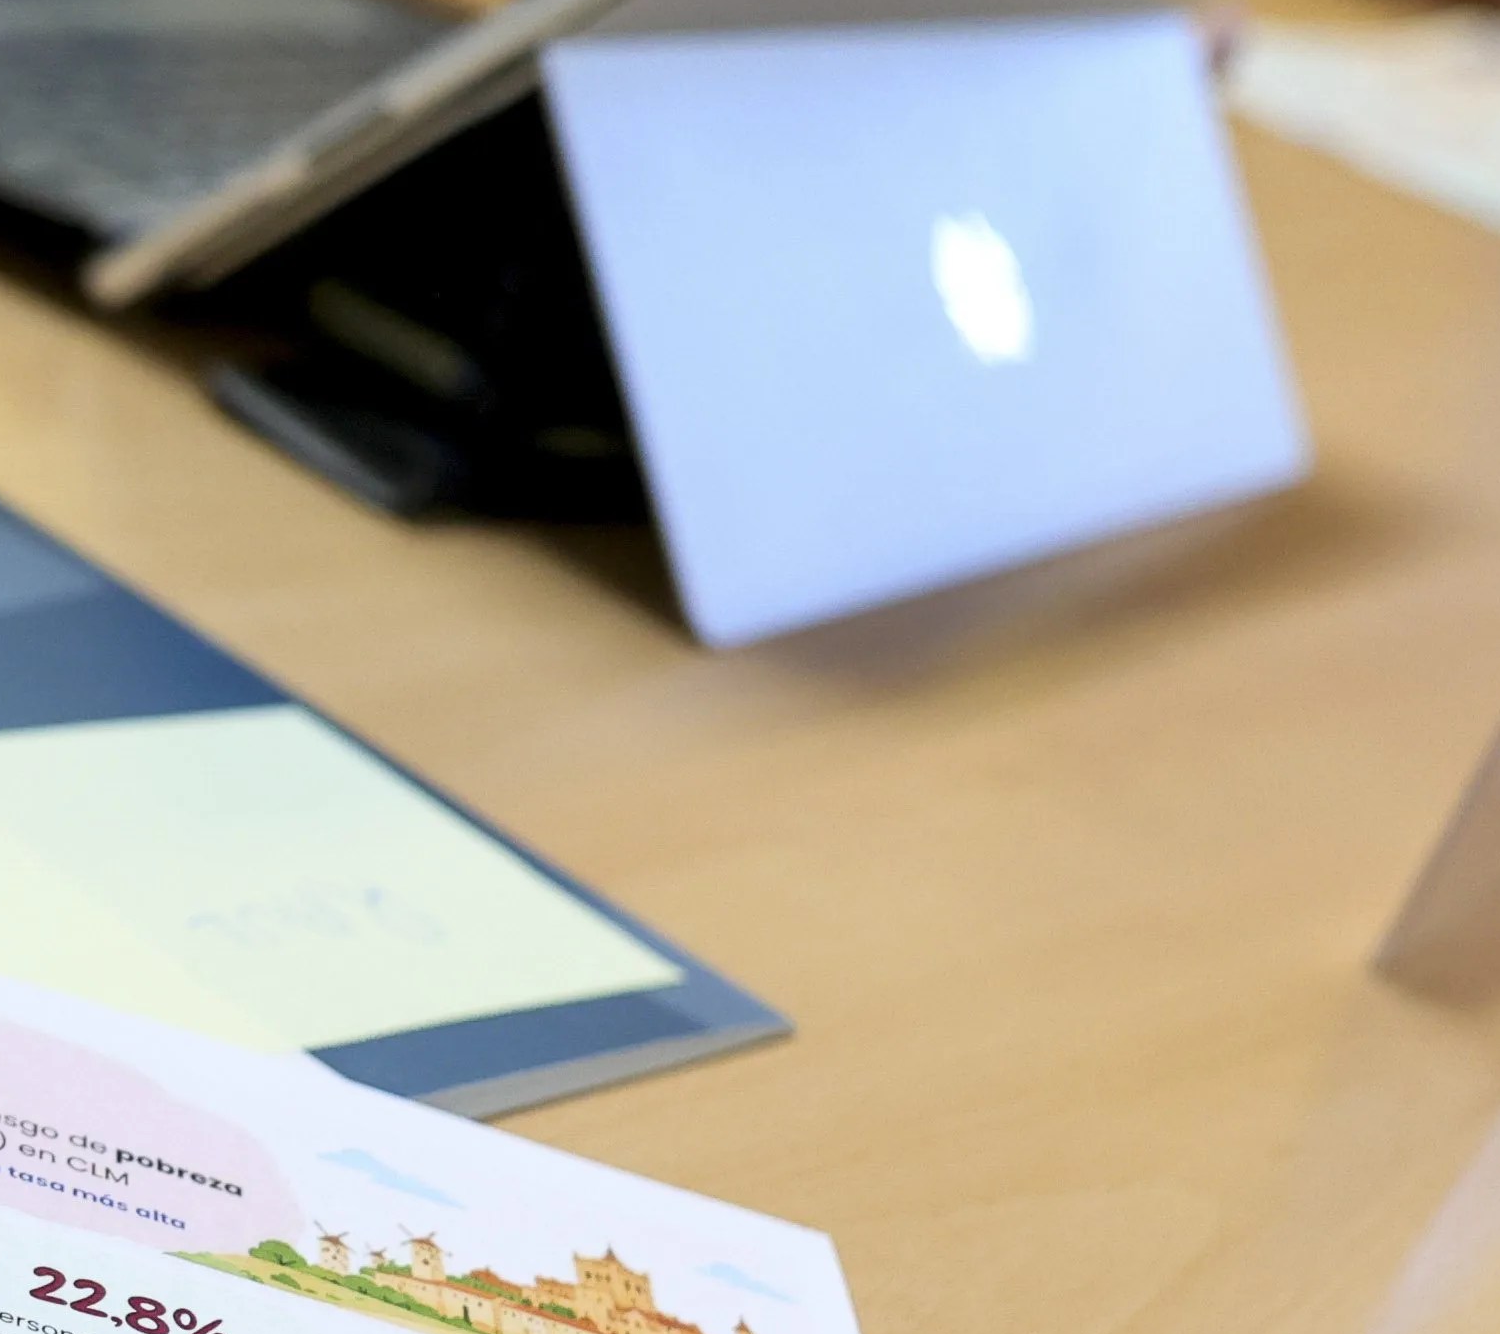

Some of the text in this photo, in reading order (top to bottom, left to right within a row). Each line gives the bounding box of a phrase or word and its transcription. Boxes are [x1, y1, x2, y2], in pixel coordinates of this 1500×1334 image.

[19, 1145, 56, 1164] en
[67, 1157, 129, 1186] CLM
[68, 1134, 108, 1155] de
[115, 1147, 243, 1198] pobreza
[8, 1166, 65, 1193] tasa
[72, 1187, 128, 1212] más
[135, 1207, 186, 1230] alta
